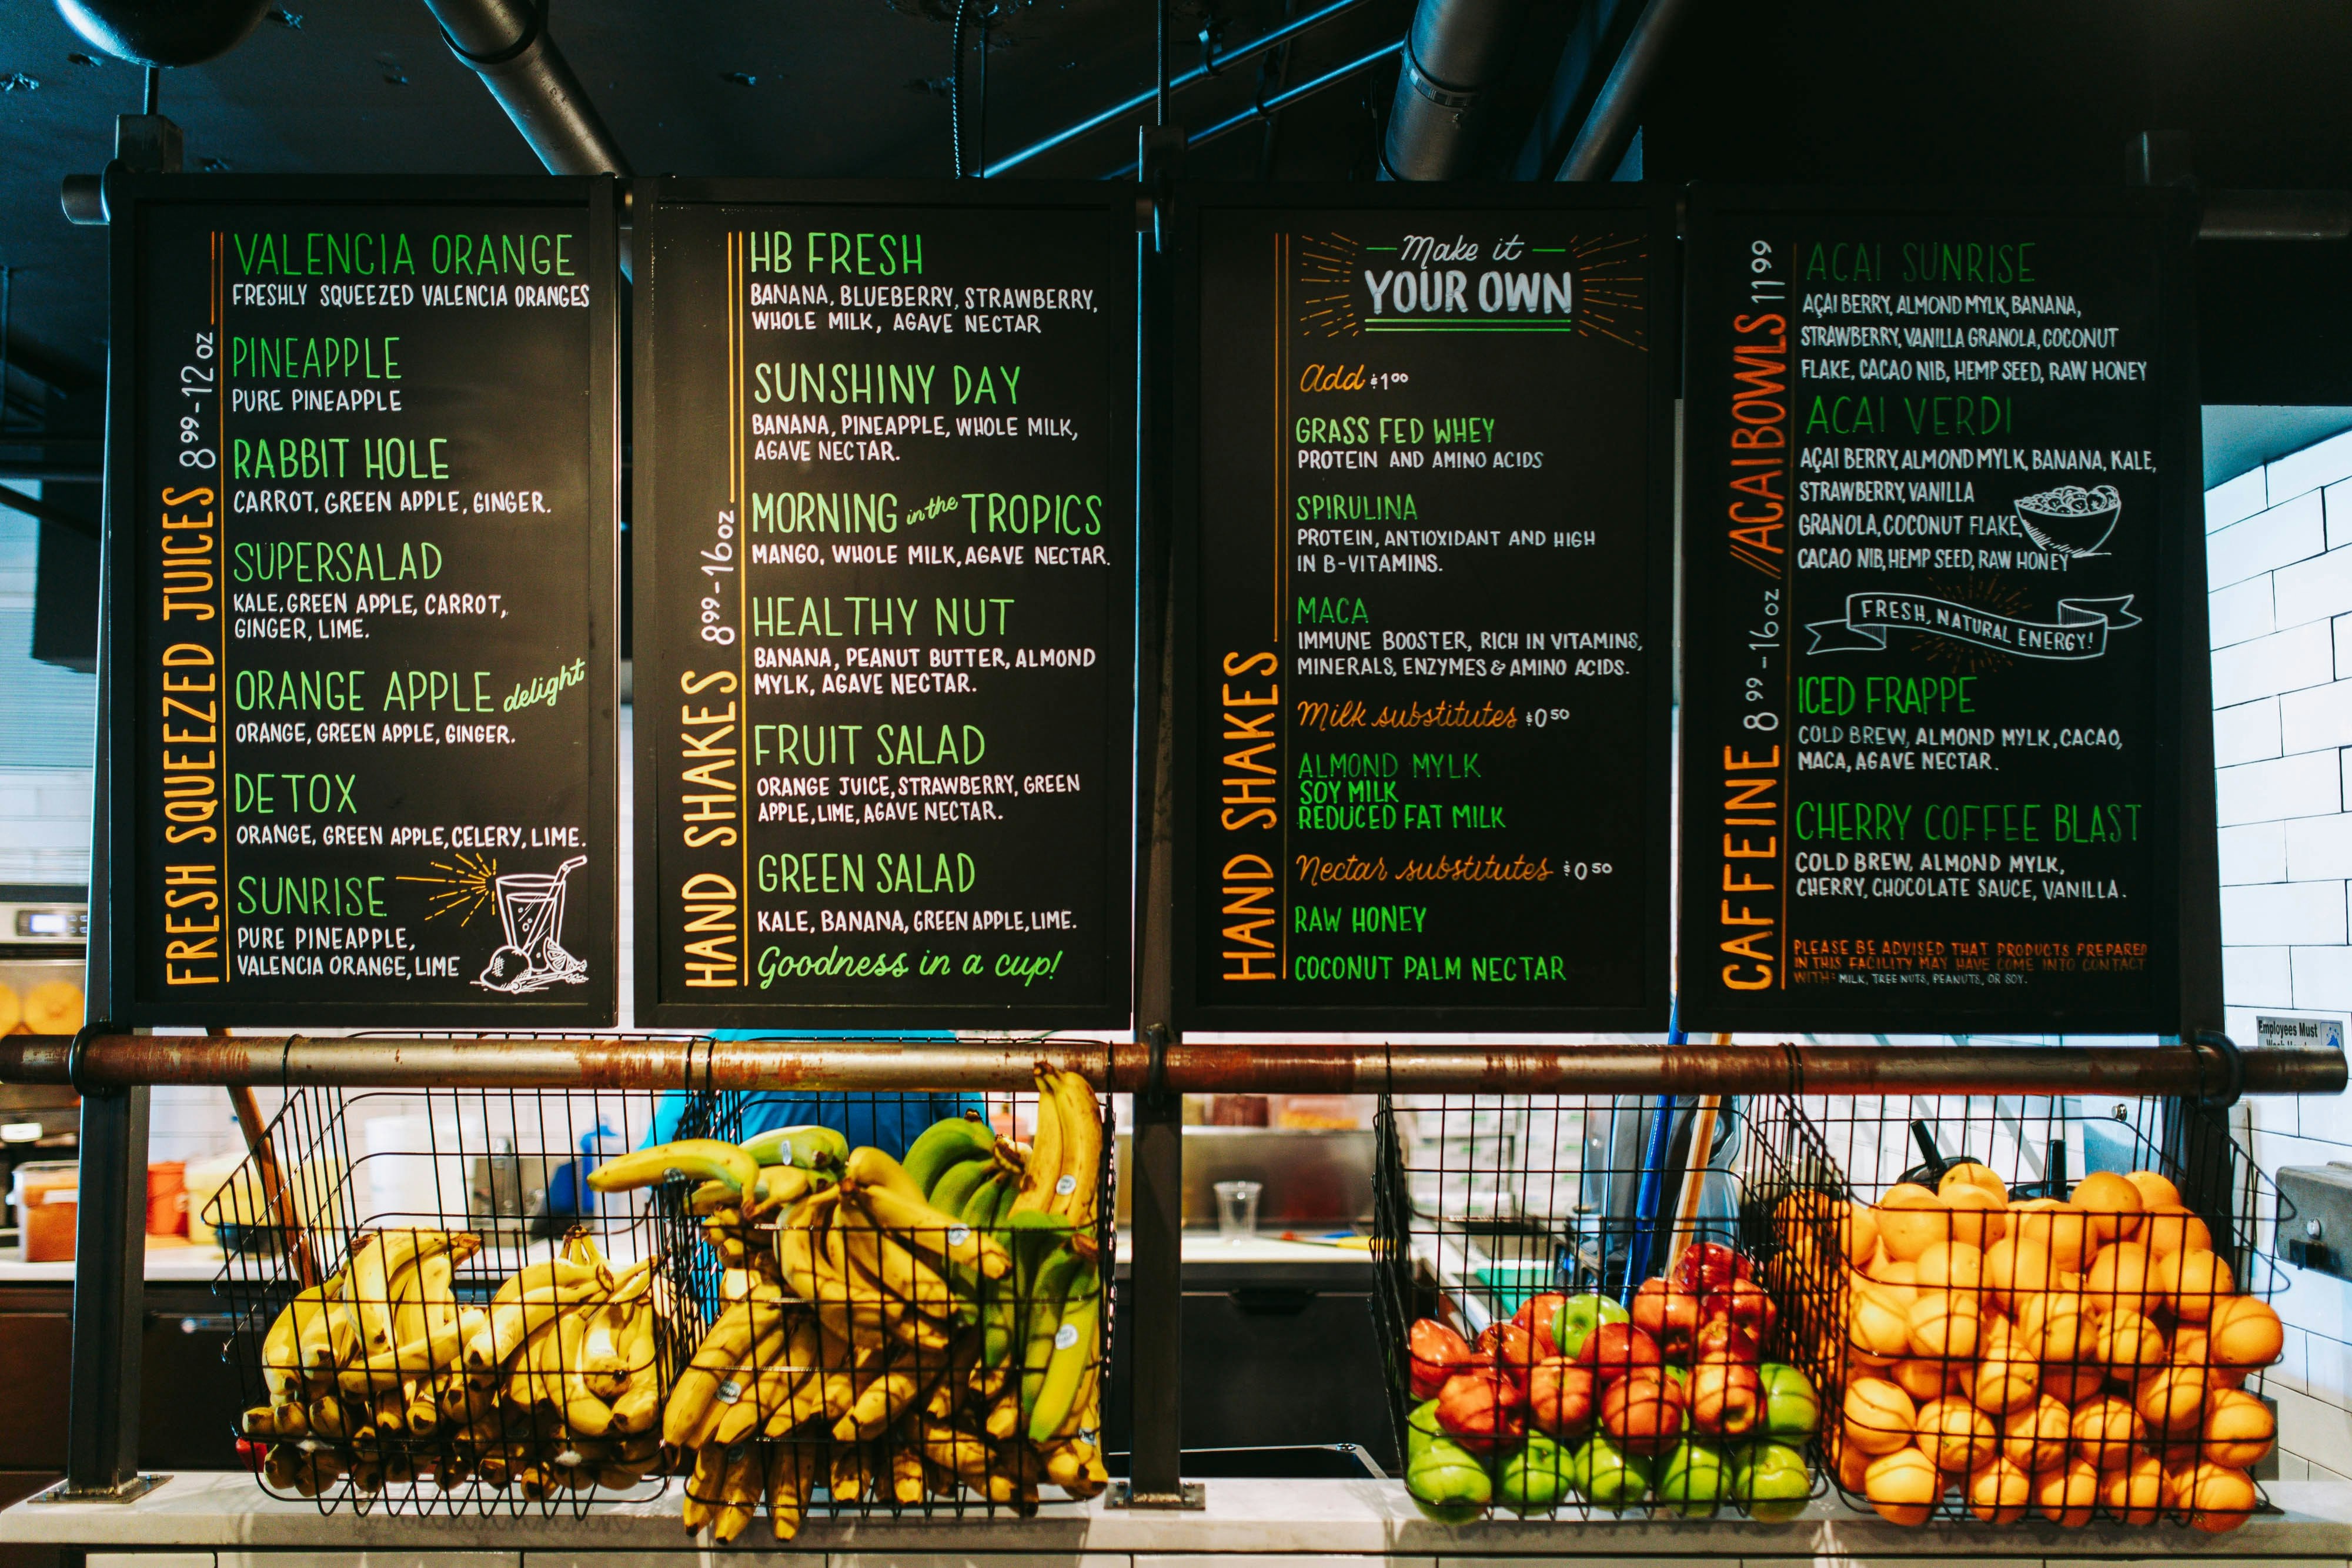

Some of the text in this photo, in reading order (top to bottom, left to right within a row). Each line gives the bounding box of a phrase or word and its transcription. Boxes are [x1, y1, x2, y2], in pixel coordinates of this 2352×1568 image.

[234, 233, 575, 276] VALENCIA ORANGE
[751, 231, 922, 275] HB FRESH
[1401, 235, 1524, 269] Make it
[1806, 242, 2035, 283] ACAI SUNRISE
[233, 284, 589, 307] FRESHLY SQUEEZED VALENCIA ORANGES
[751, 283, 1097, 313] BANANA, BLUEBERRY, STRAWBERRY,
[1365, 270, 1572, 315] YOUR OWN
[751, 311, 1041, 333] WHOLE MILK, AGAVE NECTAR
[233, 337, 402, 379] PINEAPPLE
[1801, 358, 2147, 383] FLAKE, CACAO NIB, HEMP SEED, RAW HONEY
[754, 363, 1020, 405] SUNSHINY DAY
[1300, 364, 1366, 392] Add
[1731, 314, 1786, 449] BOWLS
[1296, 416, 1494, 444] GRASS FED WHEY
[1806, 395, 2011, 435] ACAI VERDI
[235, 438, 449, 480] RABBIT HOLE
[1298, 450, 1544, 469] PROTEIN AND AMINO ACIDS
[752, 492, 1102, 536] MORNING in the TROPICS
[1296, 494, 1417, 520] SPIRULINA
[1298, 528, 1595, 548] PROTEIN, ANTIOXIDANT AND HIGH
[234, 542, 442, 582] SUPERSALAD
[1298, 554, 1442, 573] IN B-VITAMINS.
[753, 597, 1014, 637] HEALTHY NUT
[1298, 597, 1369, 624] MACA
[1862, 600, 2093, 651] FRESH, NATURAL ENERGY!
[754, 647, 1095, 671] BANANA, PEANUT BUTTER, ALMOND
[236, 657, 585, 712] ORANGE APPLE delight
[754, 673, 977, 696] MYLK, AGAVE NECTAR.
[1799, 676, 1977, 716] ICED FRAPPE
[1298, 701, 1366, 731] Milk
[1371, 700, 1518, 728] substitutes
[162, 487, 219, 985] FRESH SQUEEZED JUICES
[236, 723, 515, 745] ORANGE, GREEN APPLE, GINGER.
[754, 724, 984, 765] FRUIT SALAD
[1298, 753, 1481, 779] ALMOND MYLK
[235, 773, 357, 814] DETOX
[1300, 780, 1399, 804] SOY MILK
[680, 670, 737, 987] HAND SHAKES
[1221, 652, 1278, 980] HAND SHAKES
[1299, 804, 1505, 830] REDUCED FAT MILK
[1796, 801, 2141, 843] CHERRY COFFEE BLAST
[759, 852, 975, 893] GREEN SALAD
[1720, 745, 1779, 990] CAFFEINE
[1795, 852, 2064, 875] COLD BREW, ALMOND MYLK,
[238, 876, 387, 917] SUNRISE
[1295, 905, 1426, 933] RAW HONEY
[238, 927, 415, 951] PURE PINEAPPLE,
[1794, 940, 2147, 957] PLEASE BE ADVISED THAT PRODUCTS PREPARED
[238, 955, 460, 980] VALENCIA ORANGE, LIME
[758, 945, 1063, 989] Goodness in a cup!
[1295, 955, 1566, 981] COCONUT PALM NECTAR
[1795, 957, 2143, 971] IN THIS FACILITY MAY HAVE COME INTO CONTACT
[1839, 974, 1868, 985] MILK,
[1872, 974, 1897, 984] TREE
[1900, 974, 1929, 985] NUTS,
[1933, 974, 1984, 985] PEANUTS,
[1987, 974, 2000, 984] OR
[2259, 1020, 2318, 1038] Employees Must
